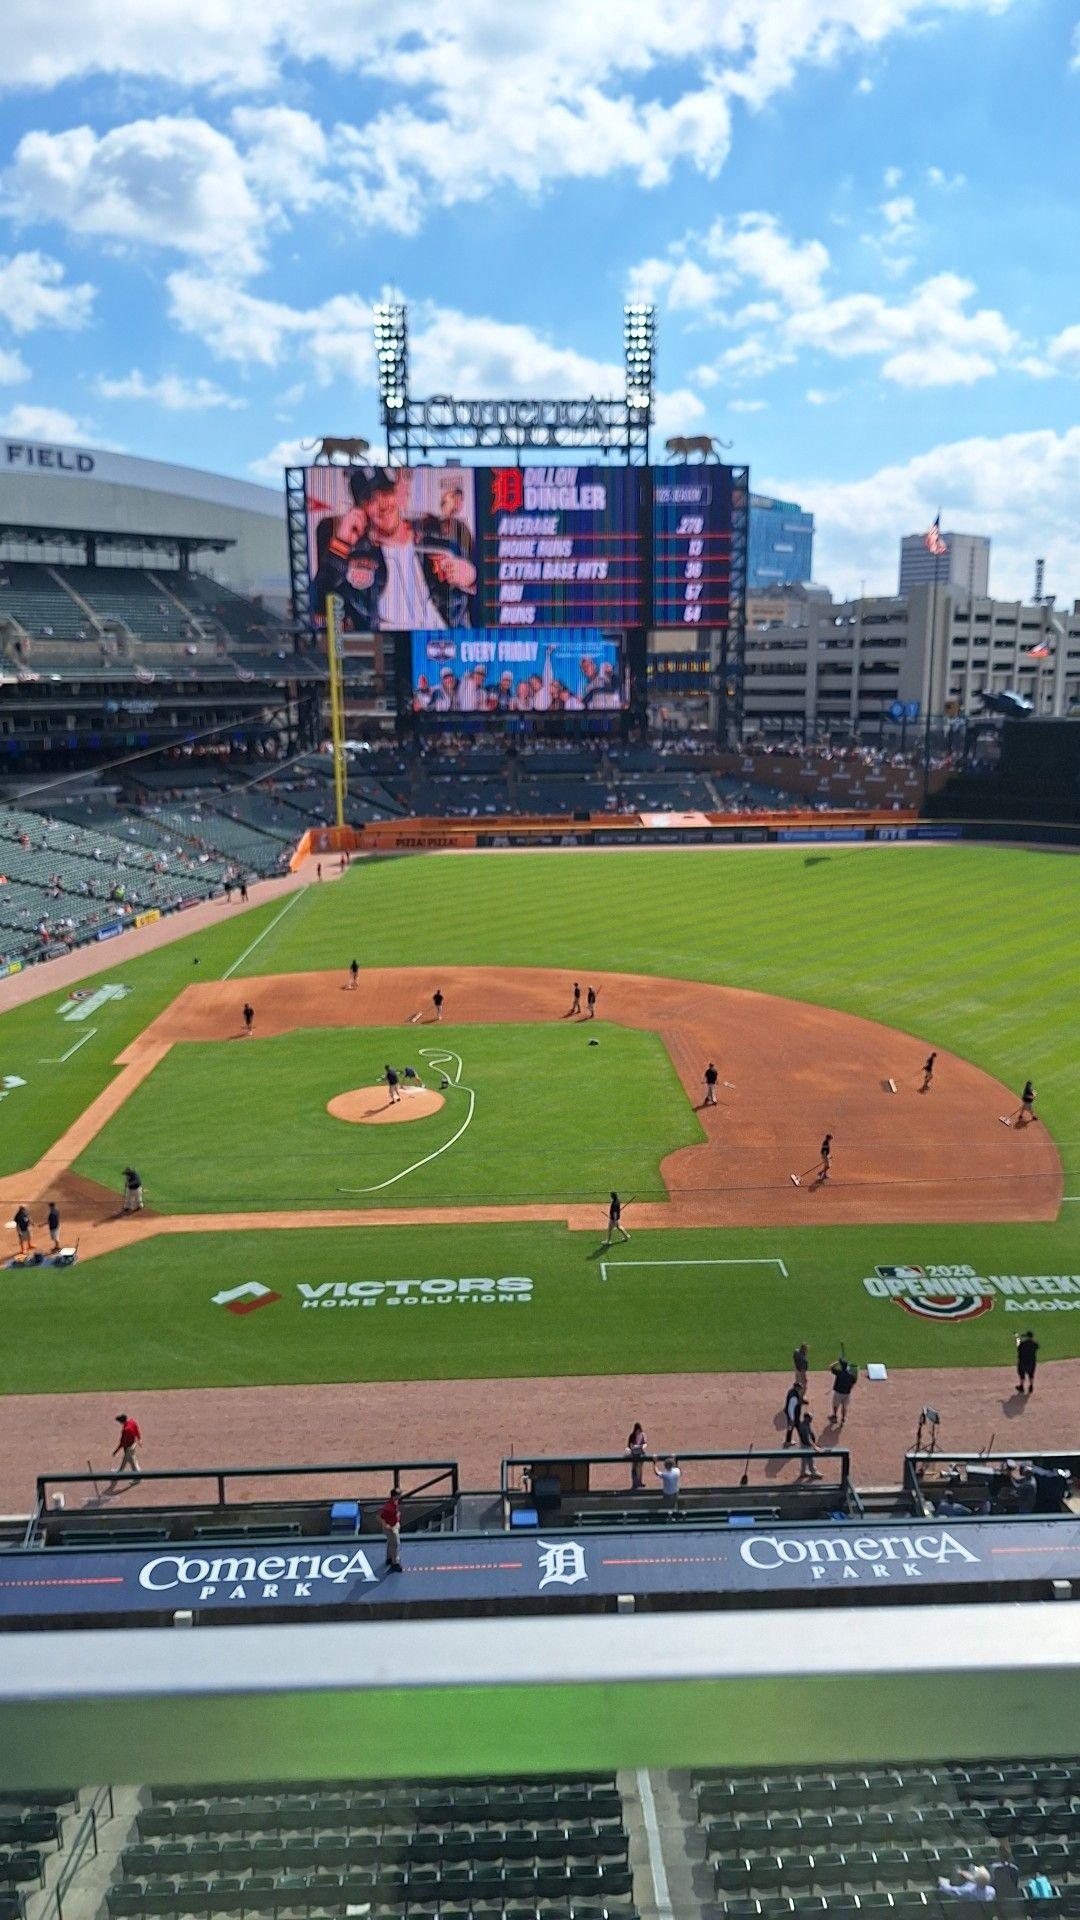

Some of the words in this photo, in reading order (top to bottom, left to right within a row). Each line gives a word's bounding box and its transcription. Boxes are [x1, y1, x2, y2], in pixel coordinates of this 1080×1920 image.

[7, 444, 96, 472] FIELD
[523, 485, 607, 511] DINGLER
[498, 516, 560, 535] AVERAGE
[498, 539, 536, 558] HOME
[536, 539, 574, 558] RUNS
[498, 561, 541, 580] EXTRA
[541, 561, 577, 580] BASE
[576, 561, 609, 580] HITS
[498, 605, 536, 624] RUNS
[460, 641, 497, 662] EVERY
[498, 641, 539, 662] FRIDAY
[395, 837, 426, 847] PIZZA!
[428, 837, 458, 847] PIZZA!
[878, 828, 907, 841] DTE
[924, 1264, 977, 1278] 2026
[296, 1276, 534, 1298] VICTORS
[862, 1276, 996, 1297] OPENING
[301, 1297, 377, 1309] HOME
[386, 1293, 533, 1307] SOLUTIONS
[810, 1562, 924, 1581] PARK
[198, 1581, 314, 1600] PARK
